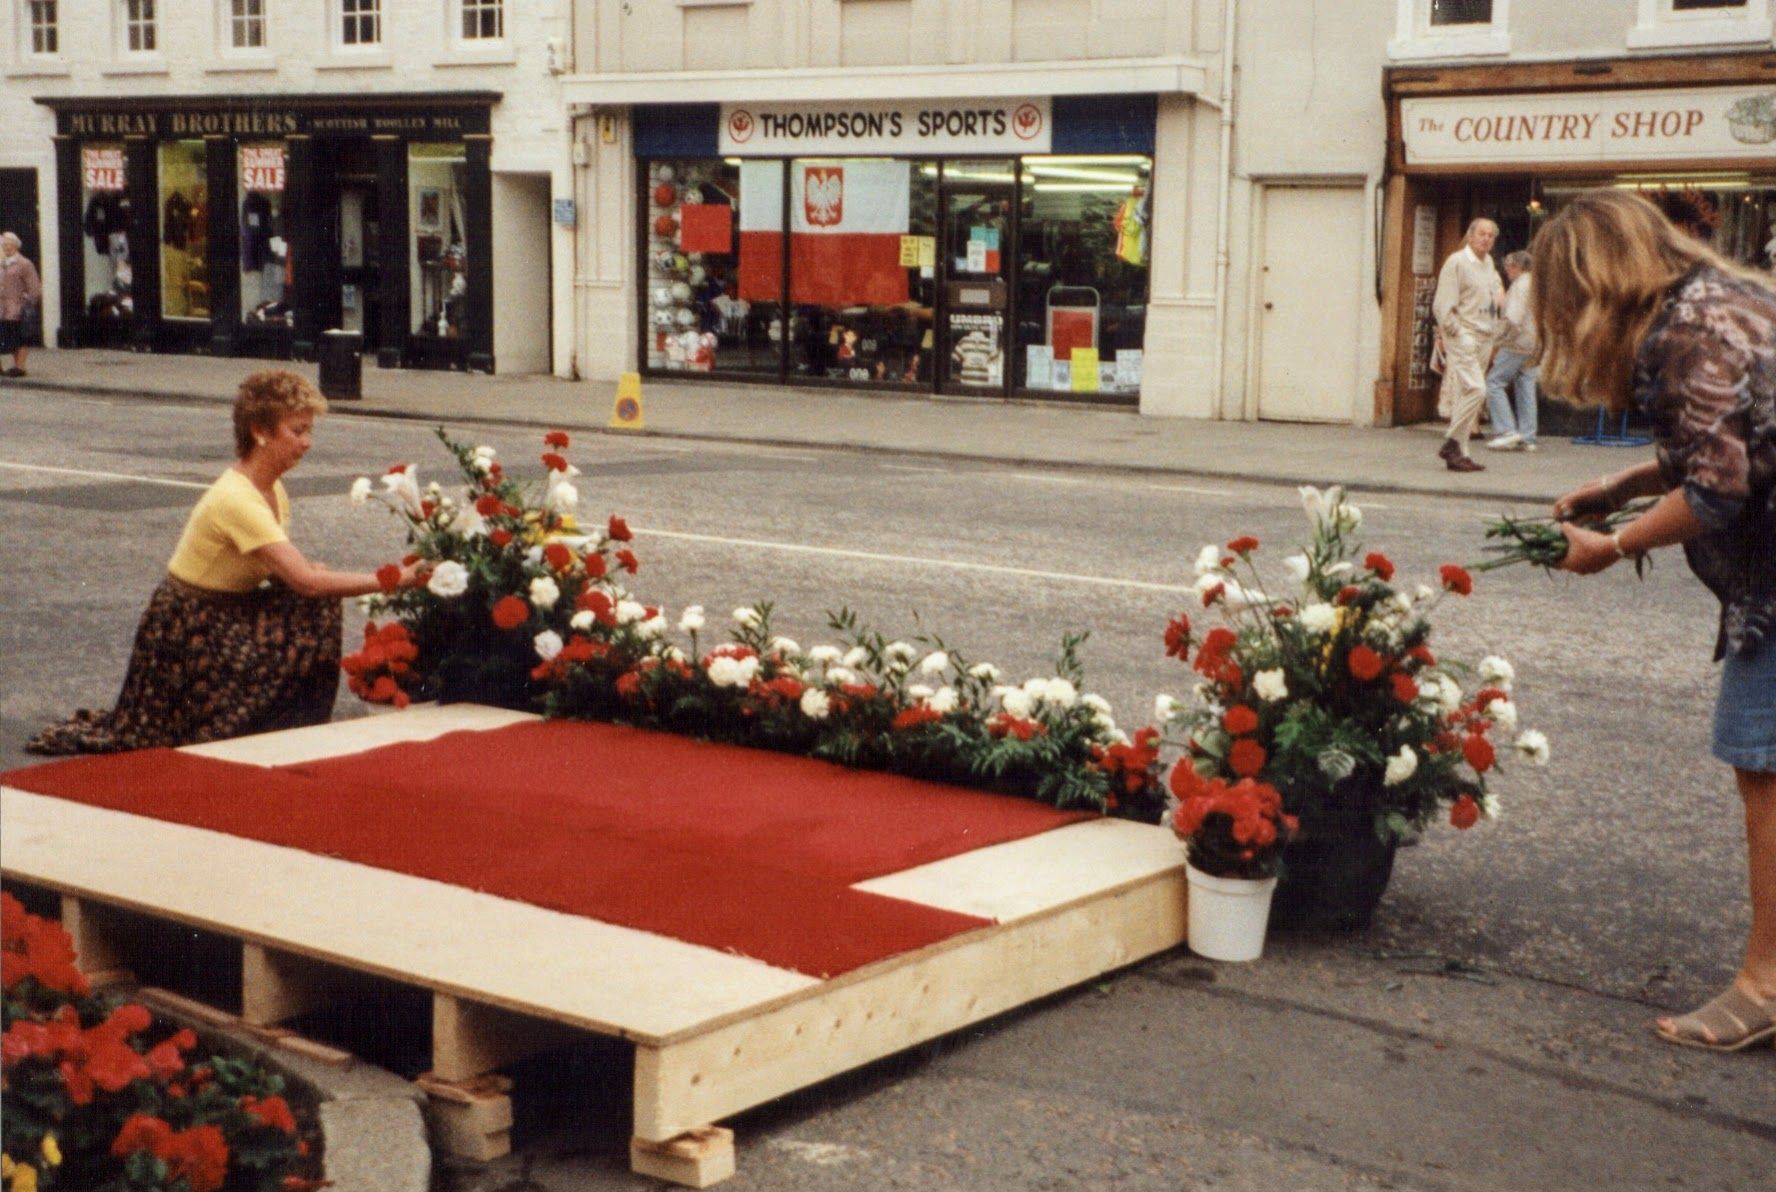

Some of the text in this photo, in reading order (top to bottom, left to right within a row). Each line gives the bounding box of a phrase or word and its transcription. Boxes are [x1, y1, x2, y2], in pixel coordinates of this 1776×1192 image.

[72, 112, 298, 133] MURRAY BROTHERS
[760, 108, 1006, 138] THOMPSON'S SPORTS
[1418, 109, 1704, 143] The COUNTRY SHOP
[86, 168, 124, 190] SALE
[244, 168, 285, 190] SALE
